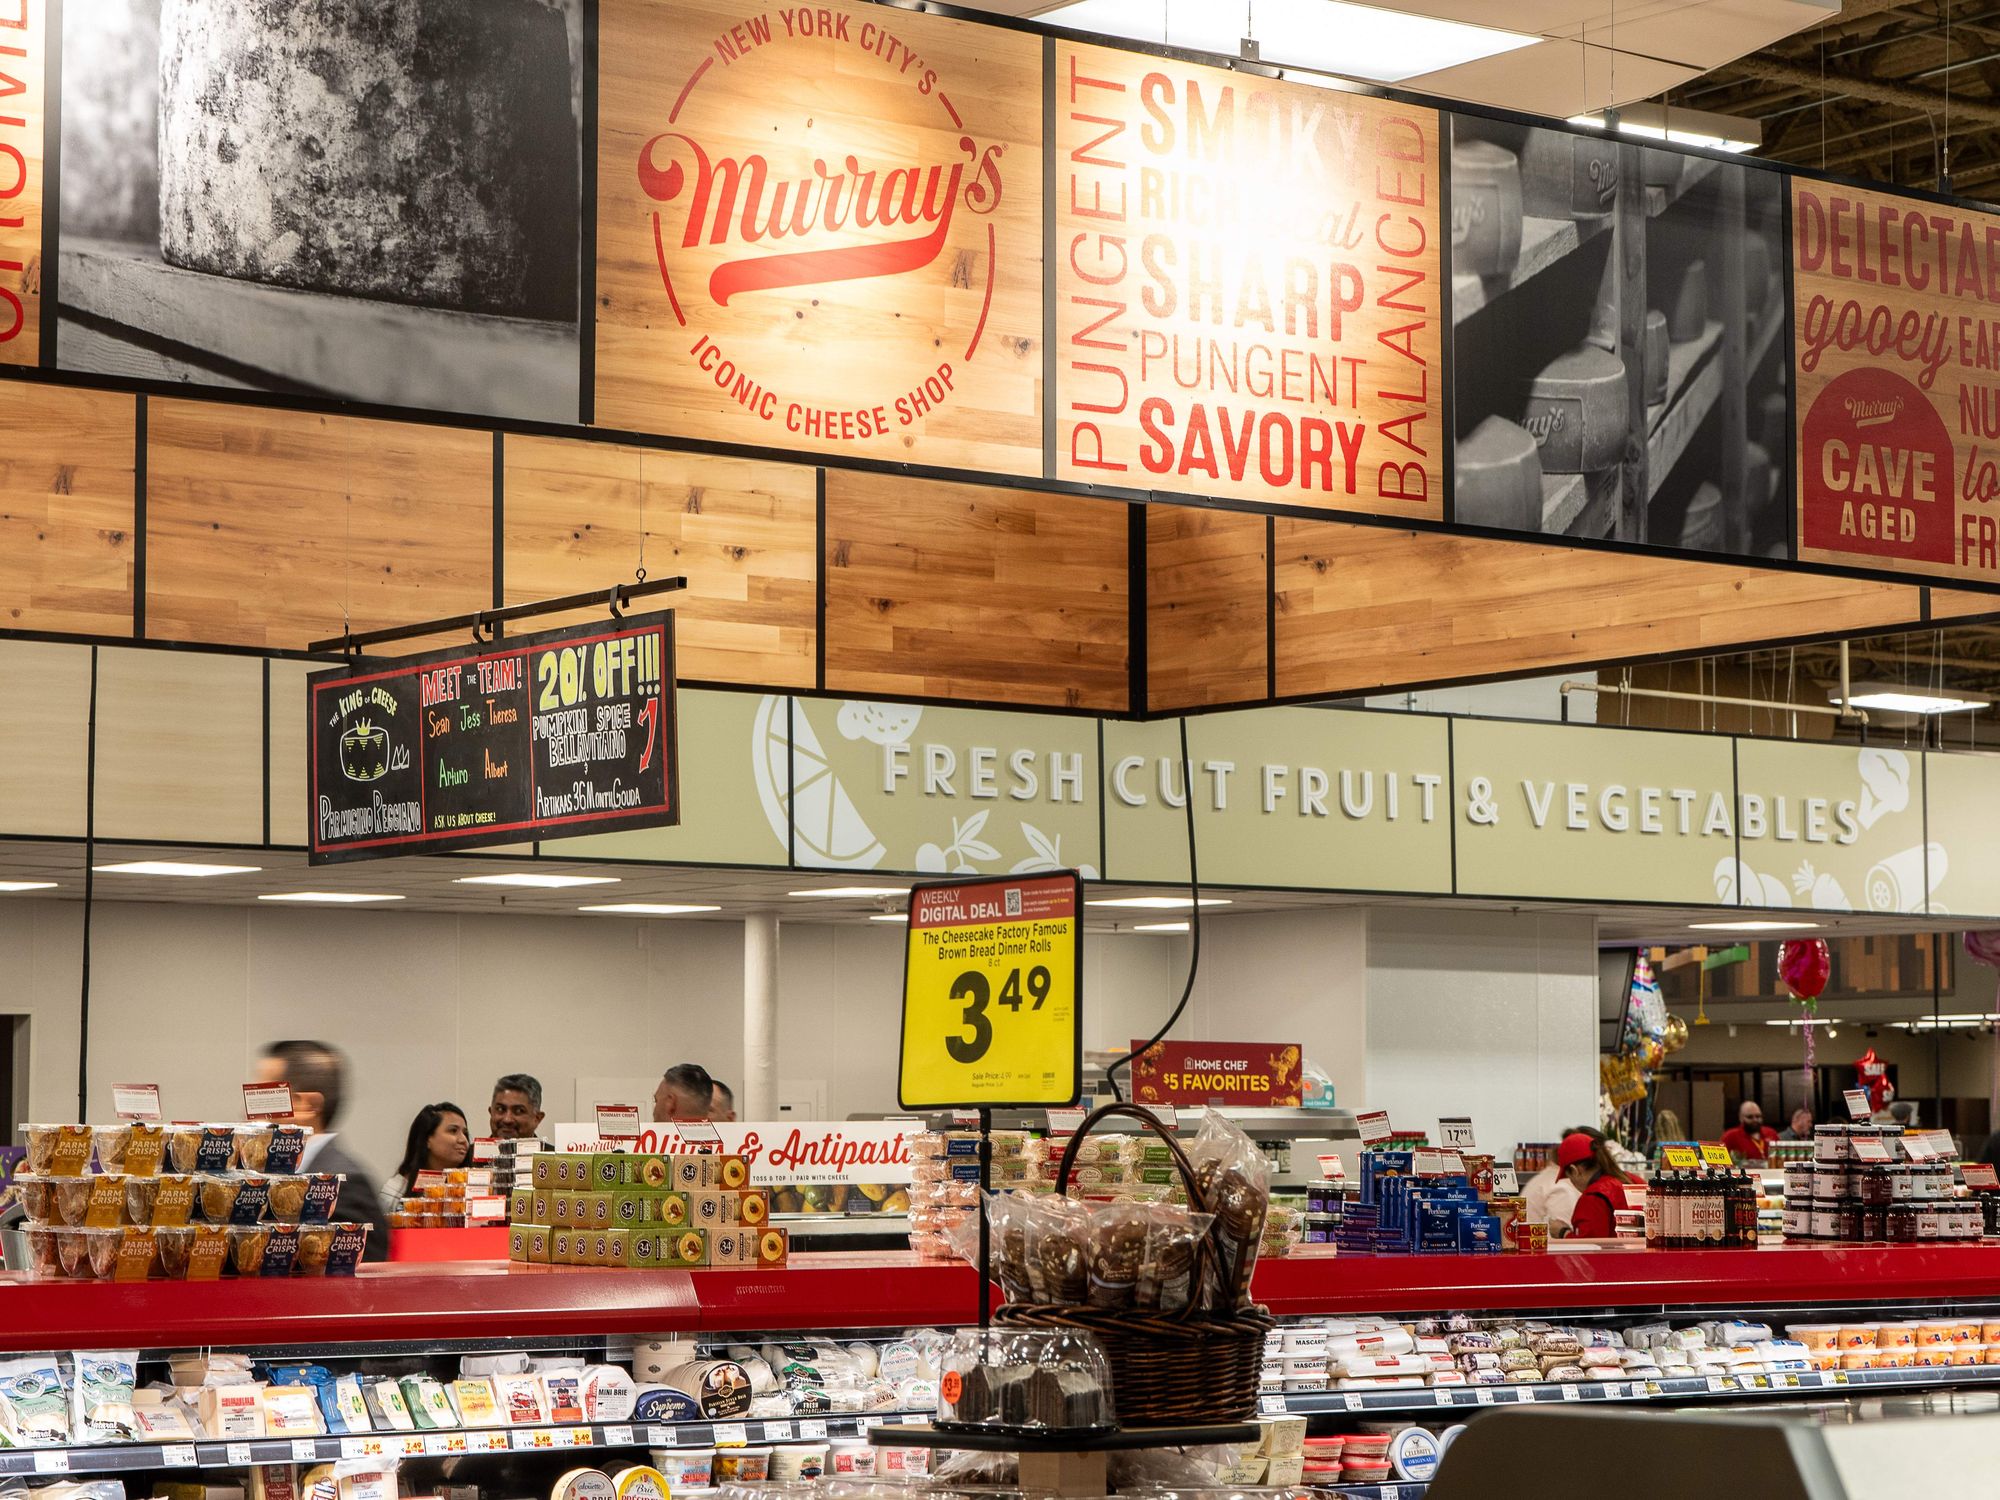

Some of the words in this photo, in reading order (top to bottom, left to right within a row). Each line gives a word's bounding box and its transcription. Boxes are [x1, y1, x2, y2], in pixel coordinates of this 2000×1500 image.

[713, 13, 771, 66] NEW
[779, 8, 850, 42] YORK
[860, 22, 938, 95] CITY'S
[1140, 72, 1365, 187] SMOKY
[638, 133, 1004, 306] Murray's
[1070, 55, 1128, 472] PUNGENT
[1140, 233, 1365, 343] SHARP
[1375, 116, 1428, 503] BALANCED
[1800, 294, 1953, 391] gooey
[1141, 329, 1367, 410] PUNGENT
[690, 335, 778, 421] ICONIC
[786, 403, 889, 440] CHEESE
[899, 363, 955, 426] SHOP
[1139, 397, 1366, 495] SAVORY
[1821, 438, 1936, 503] CAVE
[1839, 501, 1917, 544] AGED
[422, 665, 462, 707] MEET
[467, 674, 477, 686] THE
[478, 657, 522, 694] TEAM!
[538, 645, 587, 711] 20%
[329, 712, 340, 728] THE
[339, 689, 363, 718] KING
[371, 687, 398, 717] CHEESE
[428, 710, 450, 738] Sean
[460, 705, 481, 732] Jess
[486, 699, 517, 726] Theresa
[532, 708, 588, 741] PUMPKIN
[596, 703, 631, 732] SPICE
[549, 730, 627, 768] BELLAVITANO
[439, 758, 468, 788] Arturo
[484, 748, 508, 779] Albert
[573, 780, 587, 811] 36
[883, 742, 1086, 803] FRESH
[1112, 755, 1236, 810] CUT
[1262, 763, 1442, 823] FRUIT
[1467, 775, 1500, 826] &
[1520, 778, 1860, 846] VEGETABLES
[373, 790, 421, 834] REGGIANO
[434, 815, 445, 829] ASK
[446, 814, 456, 827] US
[457, 812, 474, 825] ABOUT
[475, 811, 496, 824] CHEESE!
[921, 890, 960, 905] WEEKLY
[920, 905, 967, 923] DIGITAL
[970, 902, 1002, 919] DEAL
[923, 932, 939, 945] The
[942, 928, 994, 944] Cheesecake
[997, 926, 1029, 941] Factory
[1033, 923, 1067, 935] Famous
[939, 947, 966, 960] Brown
[970, 943, 995, 958] Bread
[998, 941, 1028, 956] Dinner
[1030, 939, 1051, 953] Rolls
[1194, 1059, 1222, 1071] HOME
[1224, 1060, 1249, 1071] CHEF
[1163, 1072, 1179, 1091] $5
[1183, 1073, 1270, 1092] FAVORITES
[59, 1141, 87, 1149] PARM
[131, 1140, 160, 1149] PARM
[203, 1140, 231, 1148] PARM
[273, 1138, 300, 1146] PARM
[54, 1148, 88, 1157] CRISPS
[127, 1148, 161, 1156] CRISPS
[198, 1147, 232, 1156] CRISPS
[268, 1145, 302, 1153] CRISPS
[737, 1132, 763, 1166] &
[1672, 1154, 1692, 1162] $10.49
[1707, 1152, 1725, 1160] $10.49
[95, 1189, 123, 1197] PARM
[309, 1185, 335, 1193] PARM
[160, 1190, 189, 1198] PARM
[305, 1192, 336, 1200] CRISPS
[90, 1197, 123, 1206] CRISPS
[155, 1197, 190, 1206] CRISPS
[235, 1197, 267, 1206] CRISPS
[124, 1240, 153, 1248] PARM
[195, 1240, 225, 1248] PARM
[269, 1238, 297, 1246] PARM
[334, 1236, 362, 1244] PARM
[191, 1247, 225, 1256] CRISPS
[265, 1245, 297, 1254] CRISPS
[330, 1243, 363, 1252] CRISPS
[119, 1248, 153, 1257] CRISPS
[598, 1388, 612, 1396] MINI
[613, 1388, 628, 1396] BRIE
[648, 1400, 686, 1417] Supreme
[489, 1437, 505, 1445] 6.49
[535, 1435, 551, 1443] 5.49
[574, 1433, 590, 1441] 5.49
[364, 1443, 381, 1451] 7.49
[448, 1439, 464, 1447] 7.49
[1404, 1448, 1432, 1457] CELEBRITY
[1407, 1457, 1432, 1465] ORIGINAL
[635, 1484, 654, 1494] Brie
